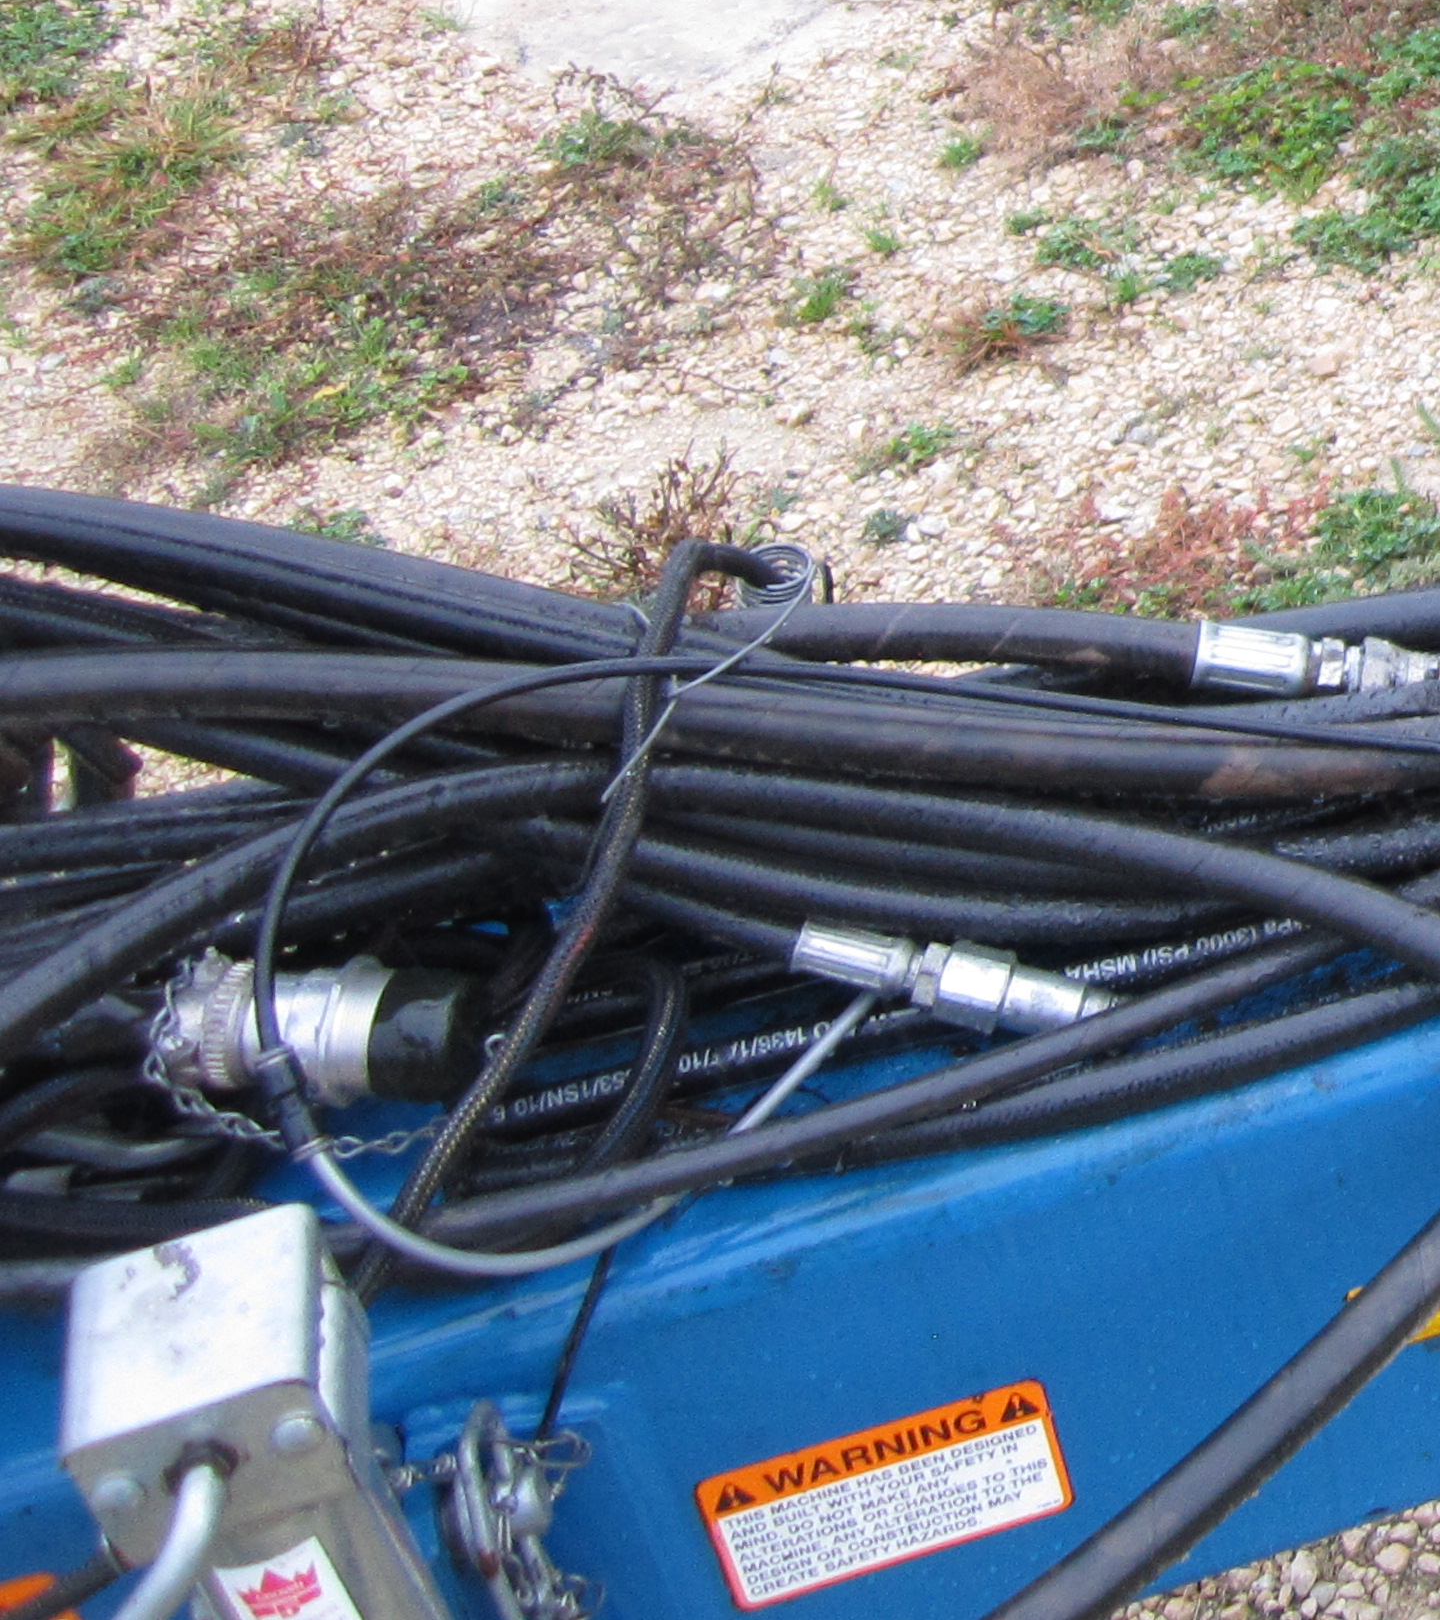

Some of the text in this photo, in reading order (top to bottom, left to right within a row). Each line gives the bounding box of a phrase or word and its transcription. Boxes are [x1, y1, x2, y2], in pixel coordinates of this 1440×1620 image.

[1064, 950, 1138, 989] MSHA
[724, 1423, 1037, 1530] THIS MACHINE HAS BEEN DESIGNED
[729, 1442, 1019, 1541] AND BUILT WITH YOUR SAFETY IN
[764, 1410, 987, 1494] WARNING
[738, 1456, 1049, 1564] ALTERATIONS OR CHANGES TO THIS
[746, 1557, 812, 1586] DESIGN
[816, 1547, 843, 1563] OR
[847, 1502, 983, 1553] CONSTRUCTION
[986, 1489, 1023, 1508] MAY
[788, 1519, 814, 1535] DO
[819, 1505, 856, 1525] NOT
[859, 1488, 910, 1512] MAKE
[914, 1474, 952, 1494] ANY
[832, 1526, 868, 1546] ANY
[872, 1491, 978, 1533] ALTERATION
[981, 1482, 1005, 1498] TO
[1009, 1470, 1043, 1489] THE
[750, 1566, 820, 1597] CREATE
[824, 1543, 892, 1573] SAFETY
